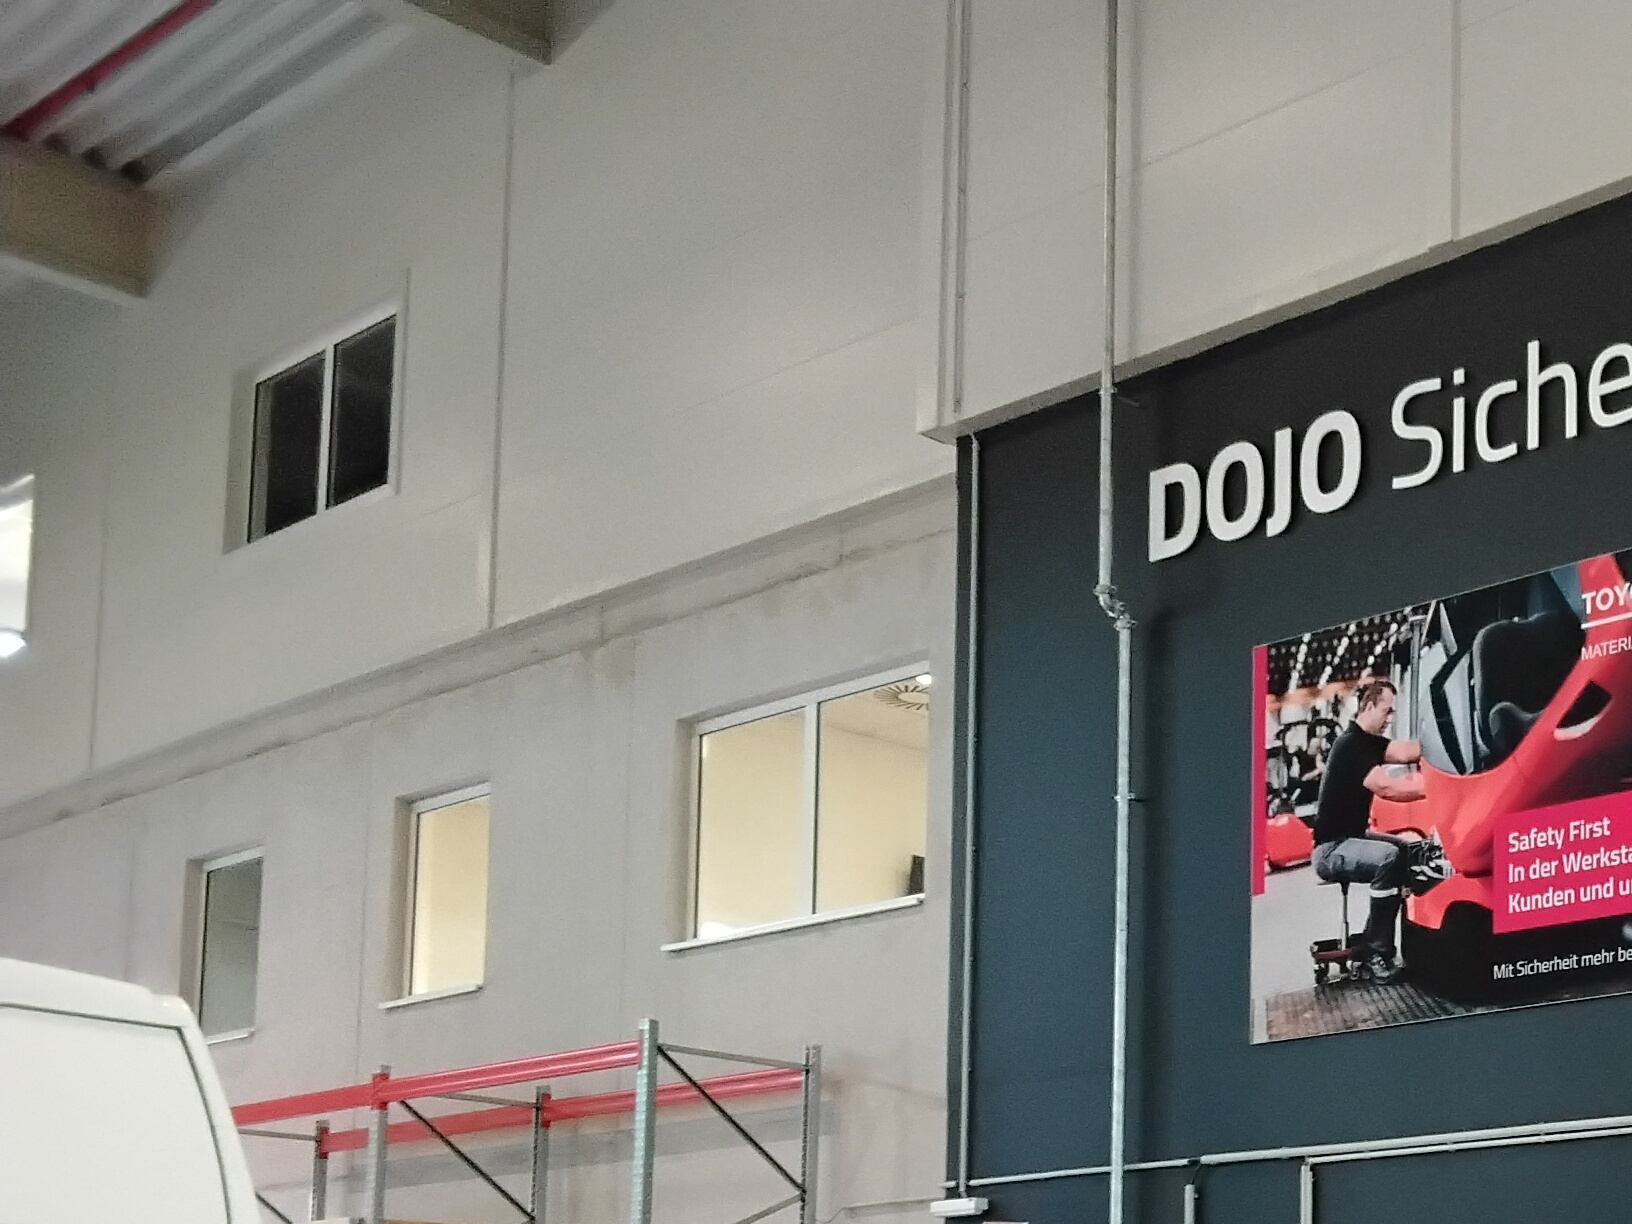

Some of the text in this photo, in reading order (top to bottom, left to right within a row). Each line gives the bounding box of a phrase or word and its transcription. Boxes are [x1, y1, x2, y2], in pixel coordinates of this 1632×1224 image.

[1148, 409, 1362, 563] DOJO
[1508, 816, 1611, 853] Safety First
[1508, 863, 1525, 884] In
[1529, 858, 1559, 880] der
[1508, 886, 1575, 914] Kunden
[1580, 876, 1614, 902] und
[1493, 963, 1514, 980] Mit
[1516, 953, 1579, 977] Sicherheit
[1581, 948, 1614, 967] mehr
